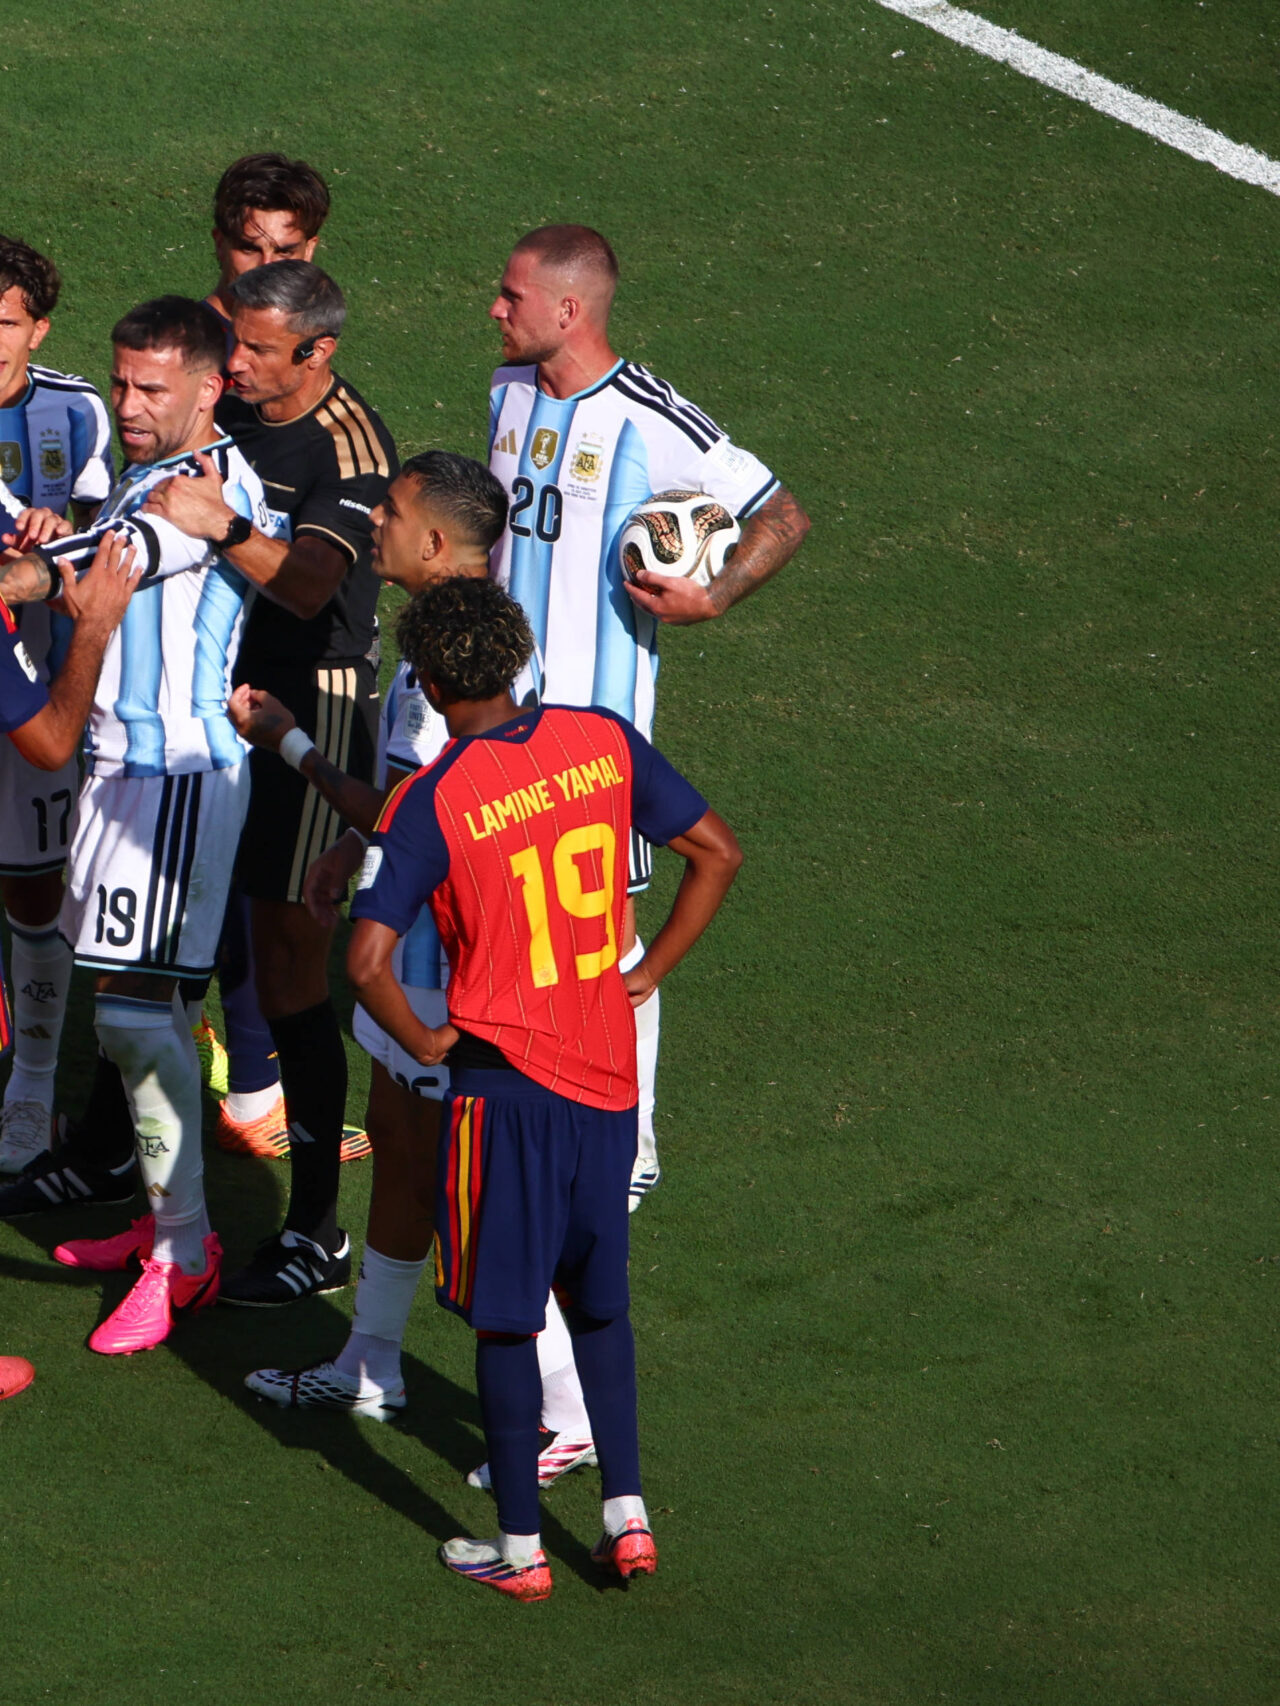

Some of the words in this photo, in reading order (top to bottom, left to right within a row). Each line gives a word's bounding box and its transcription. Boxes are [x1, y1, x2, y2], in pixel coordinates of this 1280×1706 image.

[339, 498, 372, 515] Hisens
[509, 476, 563, 543] 20
[32, 789, 71, 853] 17
[464, 778, 556, 841] LAMINE
[552, 754, 624, 802] YAMAL
[95, 884, 137, 947] 19
[509, 822, 617, 989] 19
[21, 979, 58, 1003] AFA
